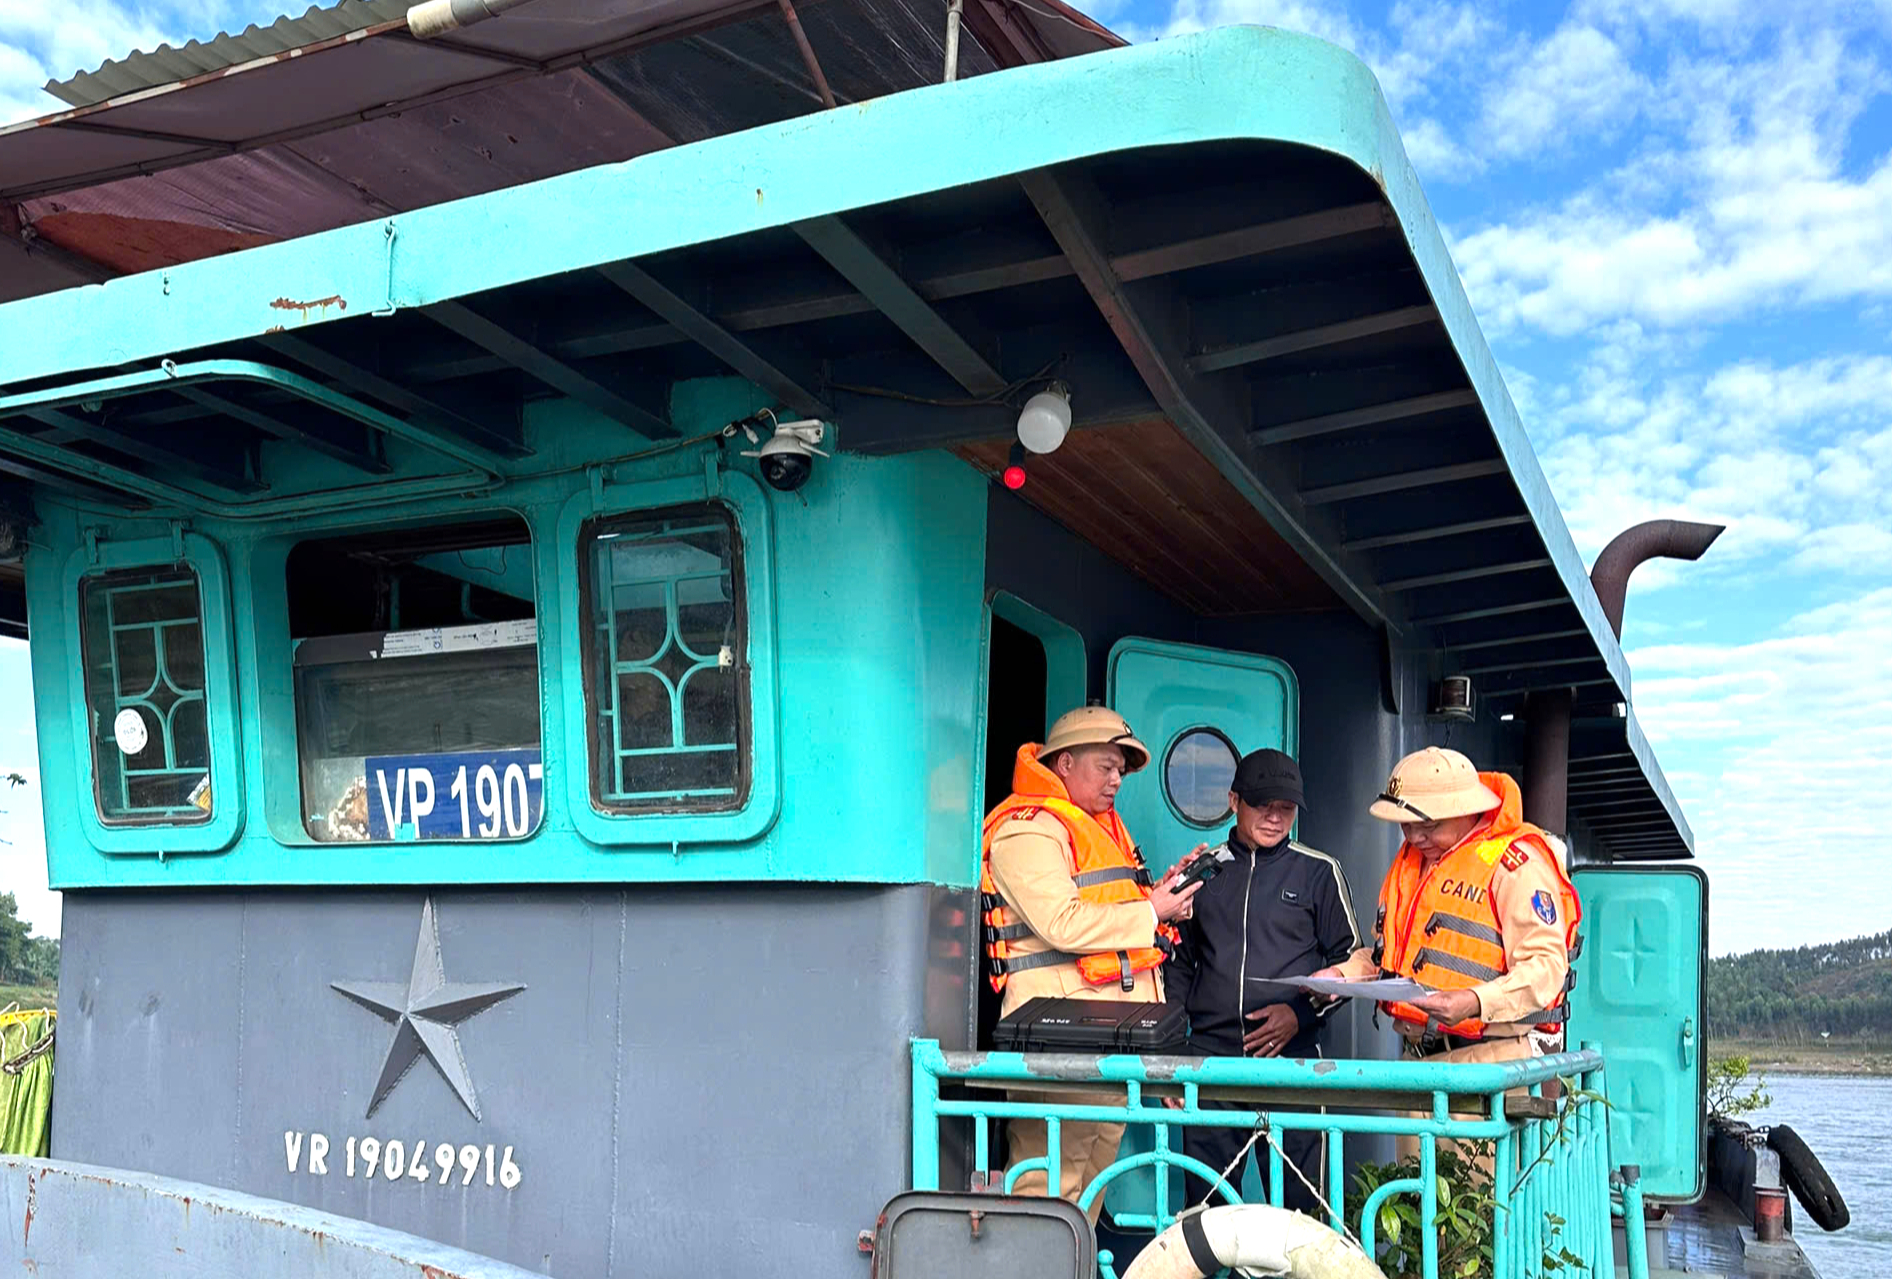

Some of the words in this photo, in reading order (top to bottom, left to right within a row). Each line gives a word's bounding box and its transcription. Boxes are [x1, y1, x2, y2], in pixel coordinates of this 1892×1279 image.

[376, 767, 436, 840] VP
[284, 1130, 330, 1175] VR
[345, 1136, 523, 1190] 19049916
